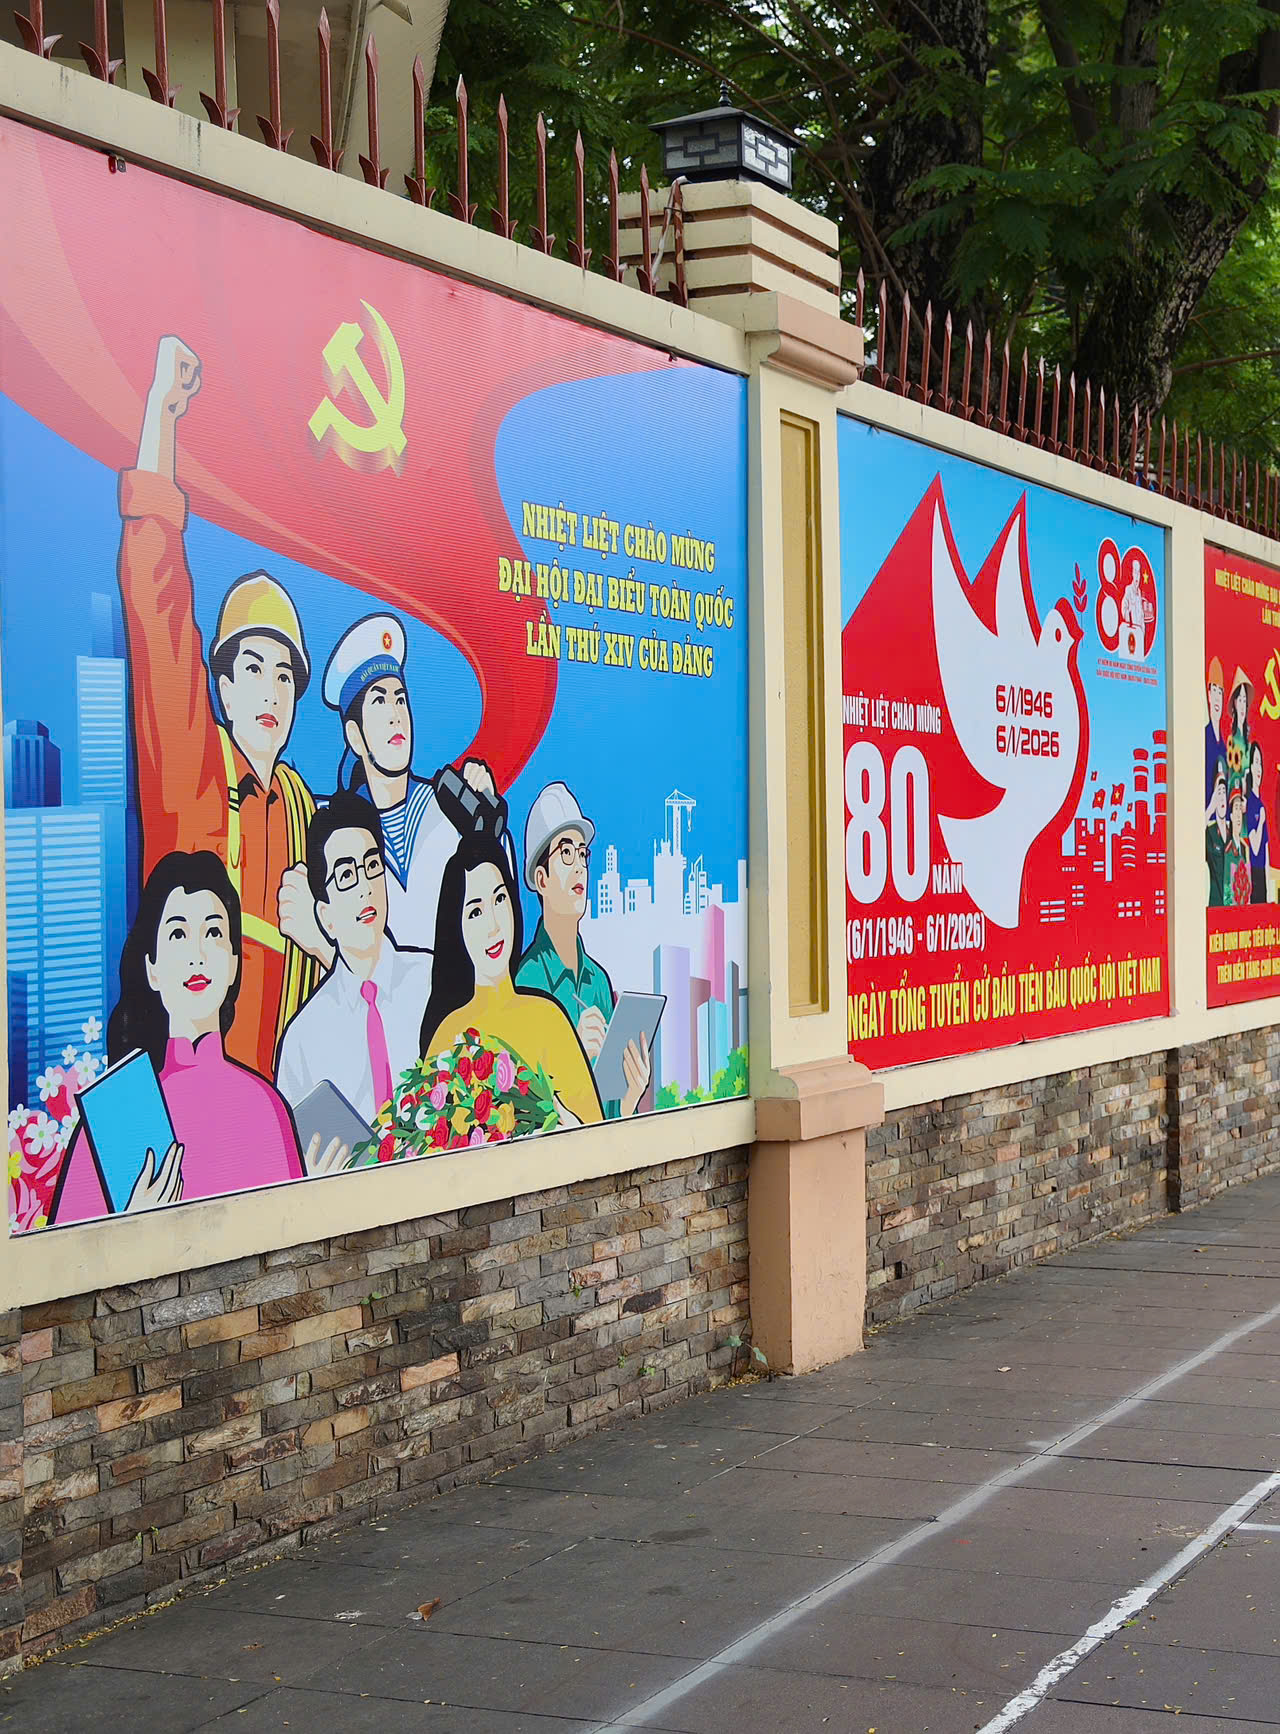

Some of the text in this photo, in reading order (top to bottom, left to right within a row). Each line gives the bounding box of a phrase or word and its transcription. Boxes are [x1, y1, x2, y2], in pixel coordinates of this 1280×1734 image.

[522, 500, 715, 573] NHIỆT LIỆT CHÀO MỪNG
[498, 556, 734, 632] ĐẠI HỘI ĐẠI BIỂU TOÀN QUỐC
[526, 608, 714, 679] LẦN THỨ XIV CỦA ĐẢNG
[843, 691, 942, 734] NHIỆT LIỆT CHÀO MỪNG
[996, 684, 1053, 718] 6/1/1946
[996, 724, 1059, 758] 6/1/2026
[845, 741, 963, 904] 80 NĂM
[847, 912, 985, 964] (6/1/1946 - 6/1/2026)
[848, 981, 886, 1041] NGÀY
[890, 969, 926, 1034] TỔNG
[930, 963, 970, 1028] TUYỂN
[973, 963, 991, 1022] CỬ
[992, 960, 1016, 1018] ĐẦU
[1018, 963, 1044, 1014] TIÊN
[1046, 954, 1067, 1010] BẦU
[1069, 951, 1097, 1010] QUỐC
[1099, 953, 1116, 1008] HỘI
[1117, 951, 1137, 1005] VIỆT
[1139, 957, 1161, 994] NAM
